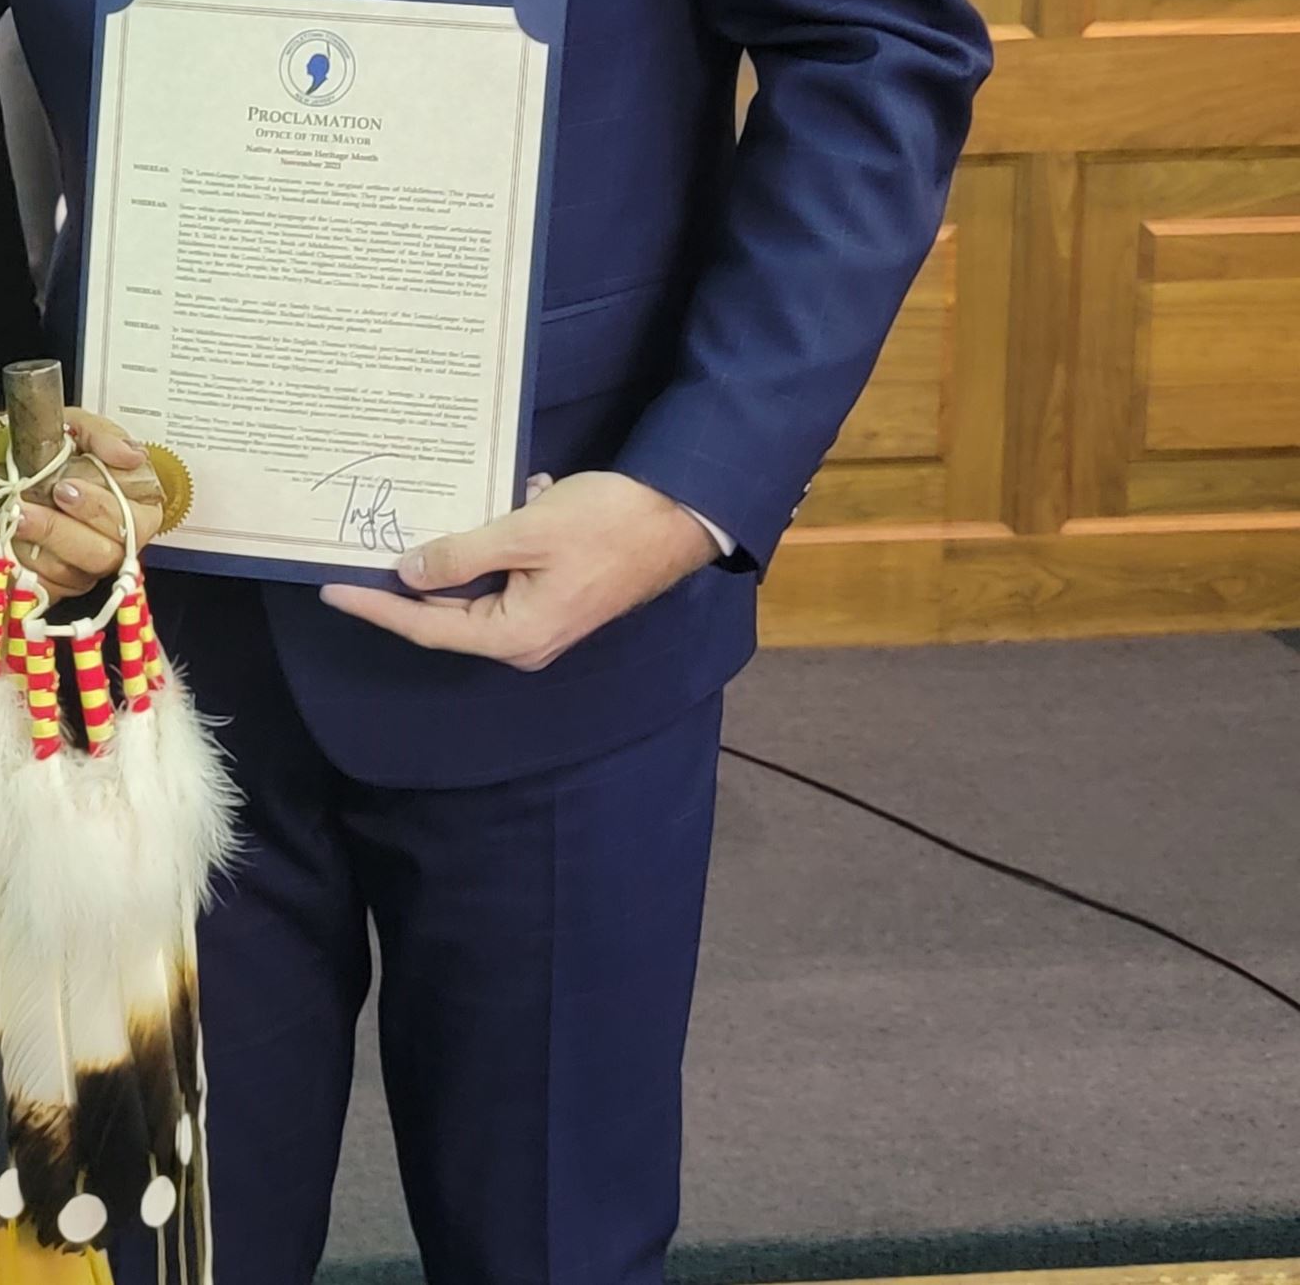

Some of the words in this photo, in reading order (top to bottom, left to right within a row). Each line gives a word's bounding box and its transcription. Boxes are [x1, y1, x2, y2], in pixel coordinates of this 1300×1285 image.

[247, 105, 383, 131] PROCLAMATION
[255, 127, 291, 140] OFFICE
[294, 131, 307, 141] OF
[331, 133, 372, 146] MAYOR
